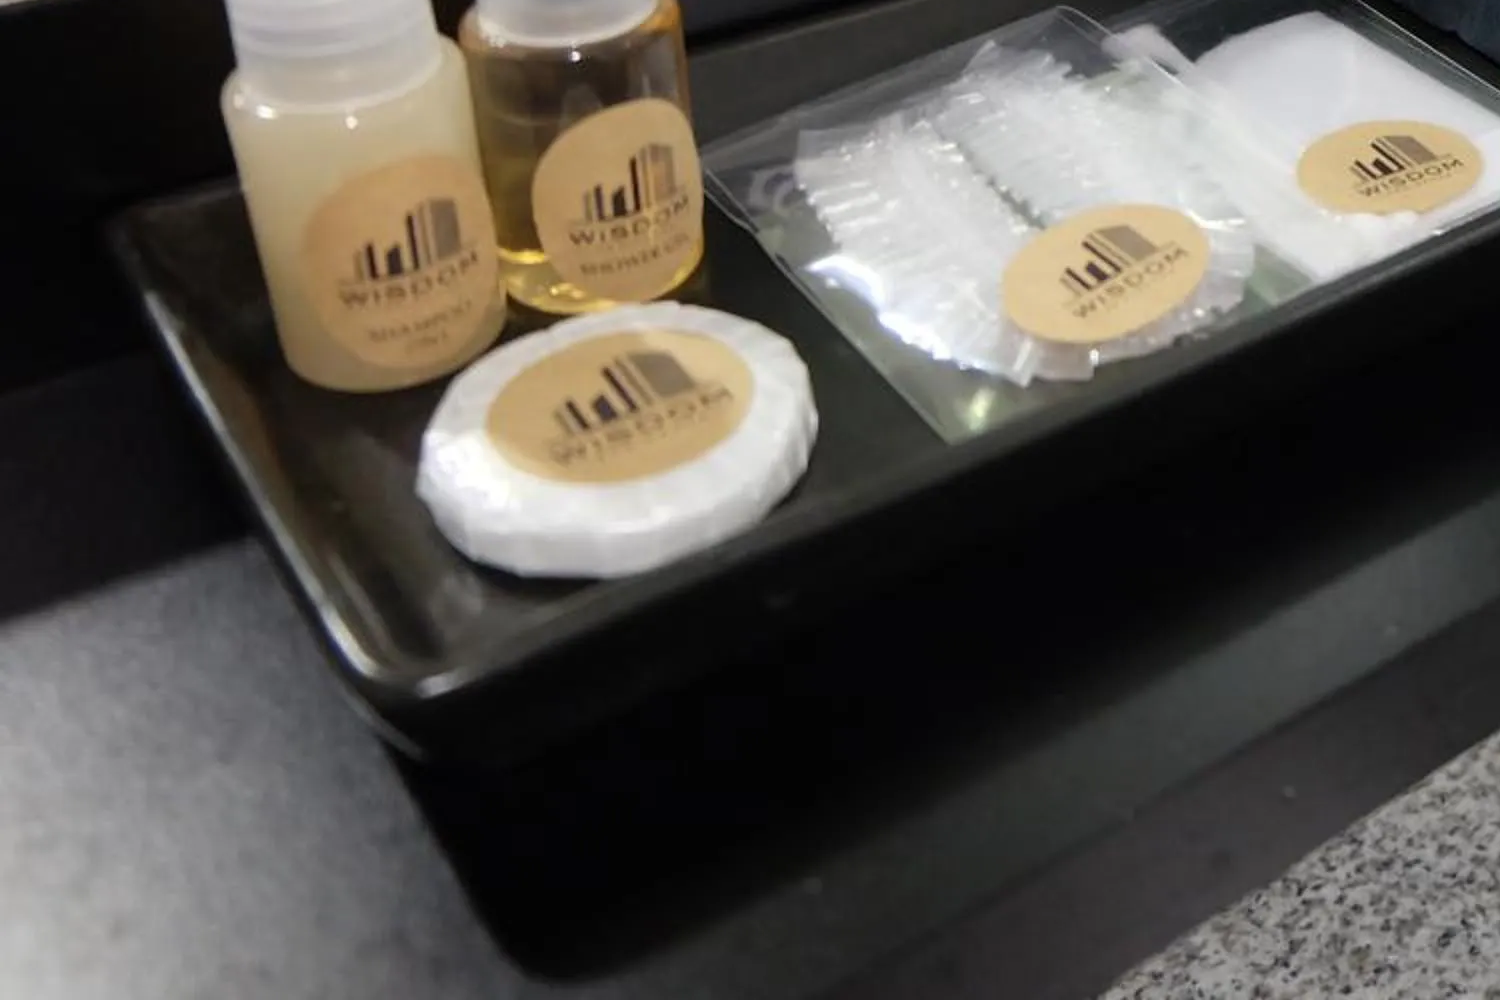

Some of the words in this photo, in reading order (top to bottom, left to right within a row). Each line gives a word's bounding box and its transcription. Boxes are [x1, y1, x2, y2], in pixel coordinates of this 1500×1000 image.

[1358, 158, 1464, 197] WISDOM
[568, 193, 689, 245] WISDOM
[338, 250, 478, 309] WISDOM
[1072, 246, 1190, 319] WISDOM
[550, 386, 734, 468] WISDOM
